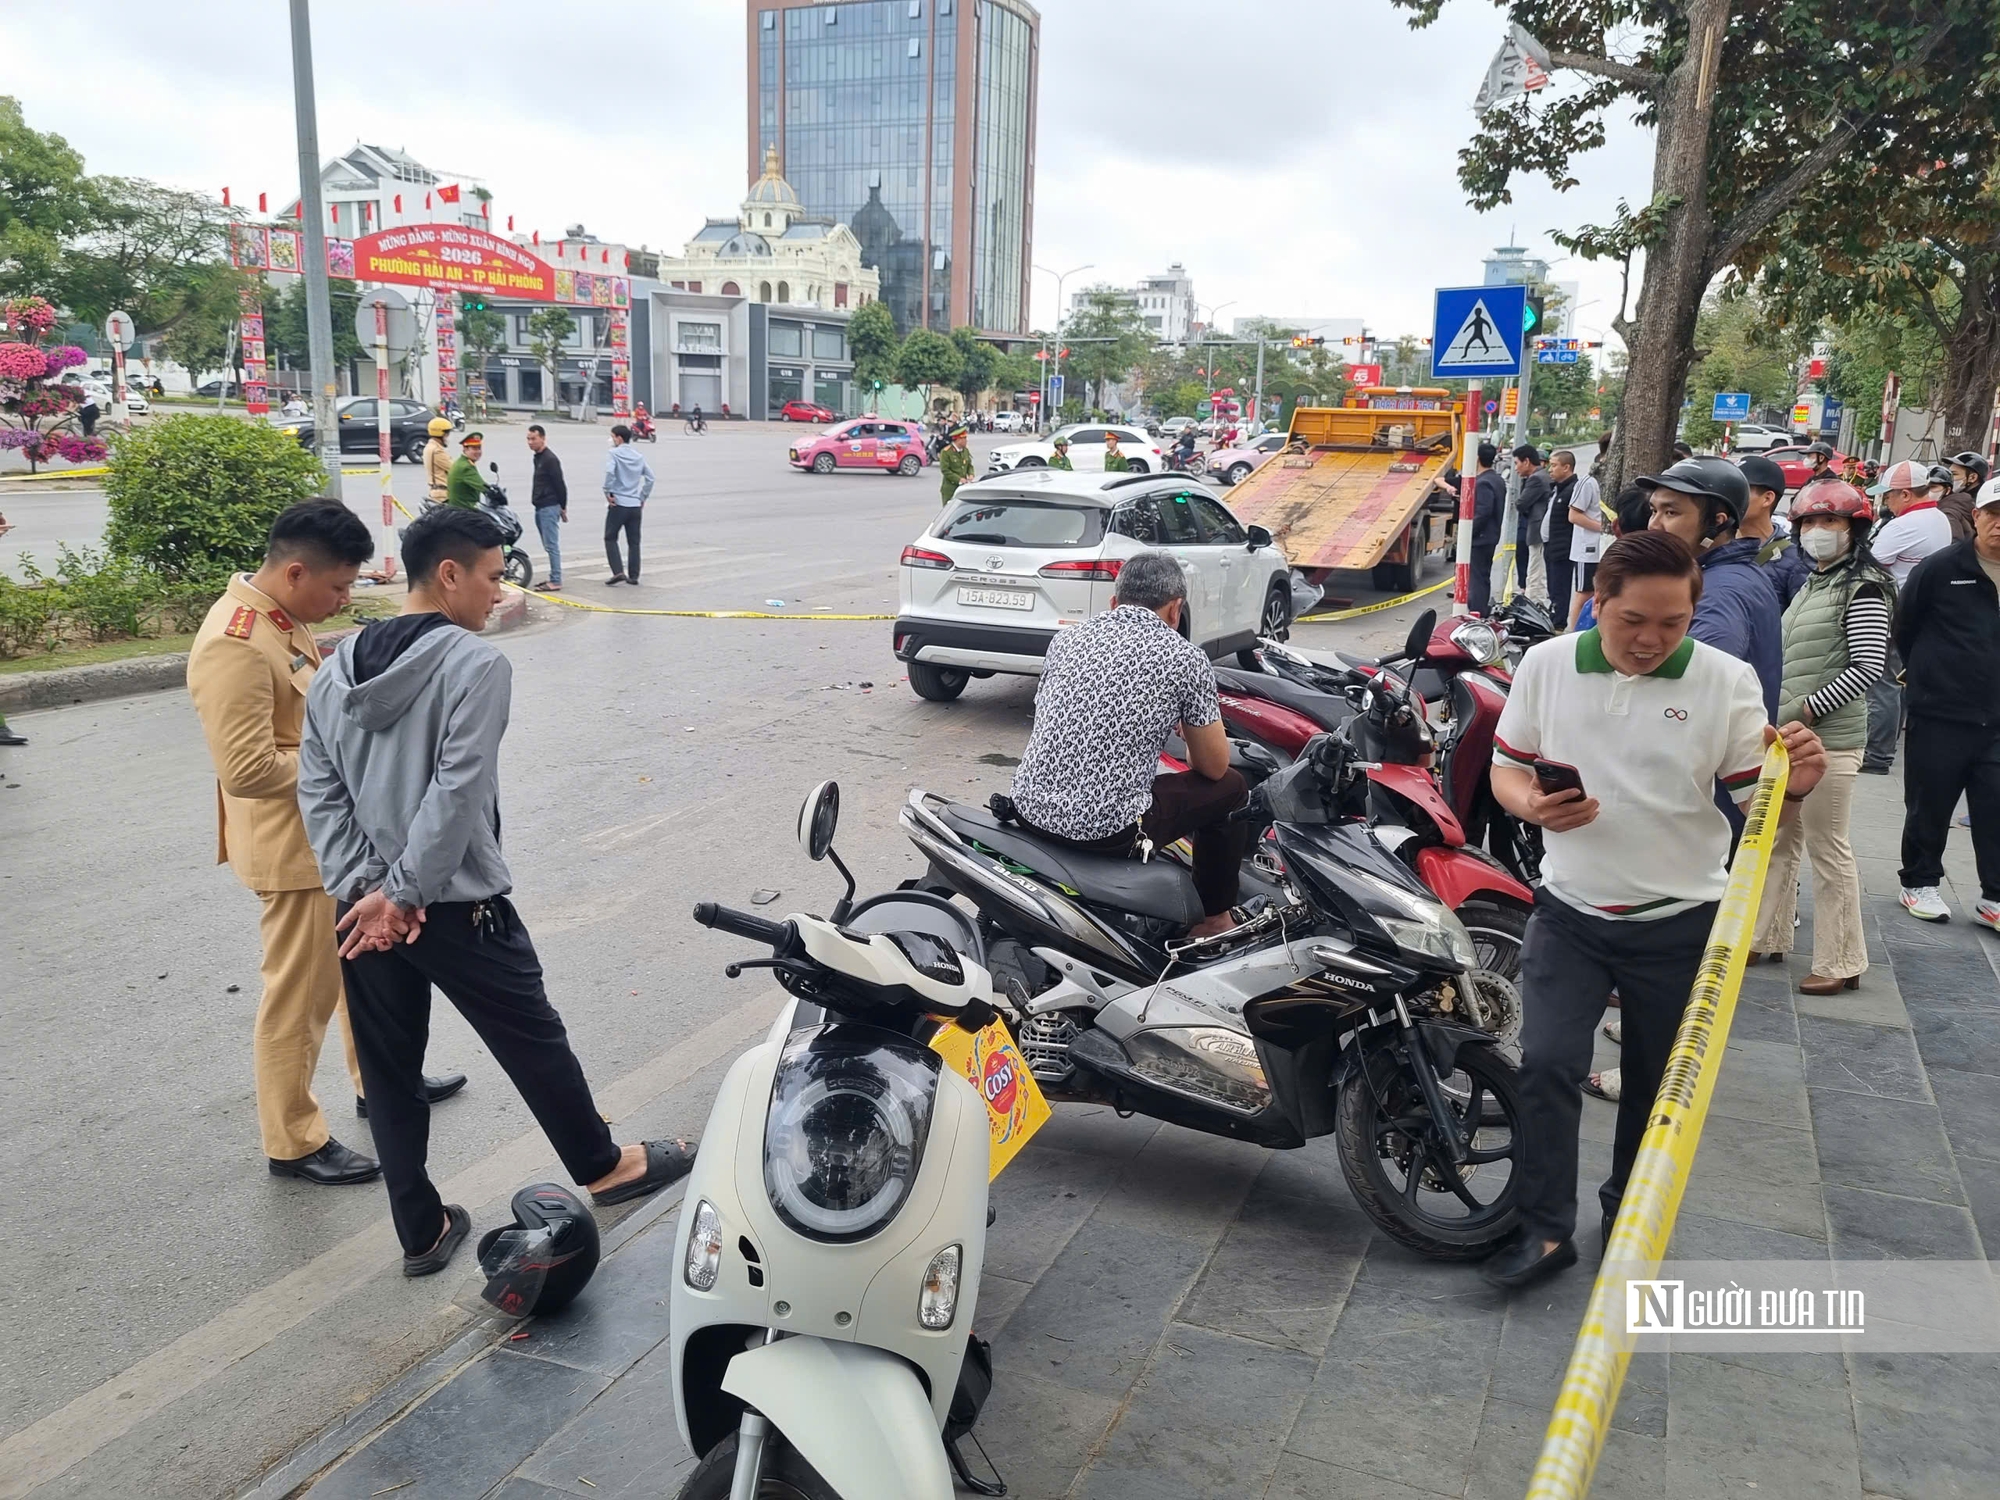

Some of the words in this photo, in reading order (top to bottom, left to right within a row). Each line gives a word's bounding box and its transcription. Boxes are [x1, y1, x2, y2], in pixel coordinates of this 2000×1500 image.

[378, 234, 407, 252] MỪNG
[408, 227, 435, 245] ĐẢNG
[441, 228, 468, 244] MỪNG
[469, 234, 495, 251] XUÂN
[440, 246, 482, 265] 2026
[370, 257, 421, 276] PHƯỜNG
[423, 260, 444, 279] HẢI
[446, 266, 463, 280] AN
[472, 269, 486, 283] TP
[488, 269, 506, 286] HẢI
[508, 273, 544, 291] PHÒNG
[970, 576, 1016, 584] CROSS
[966, 590, 1027, 606] 15A-823.59
[932, 961, 960, 974] HONDA
[1323, 971, 1376, 993] HONDA
[829, 1078, 881, 1095] SCOOPY
[985, 1059, 1013, 1101] COSY
